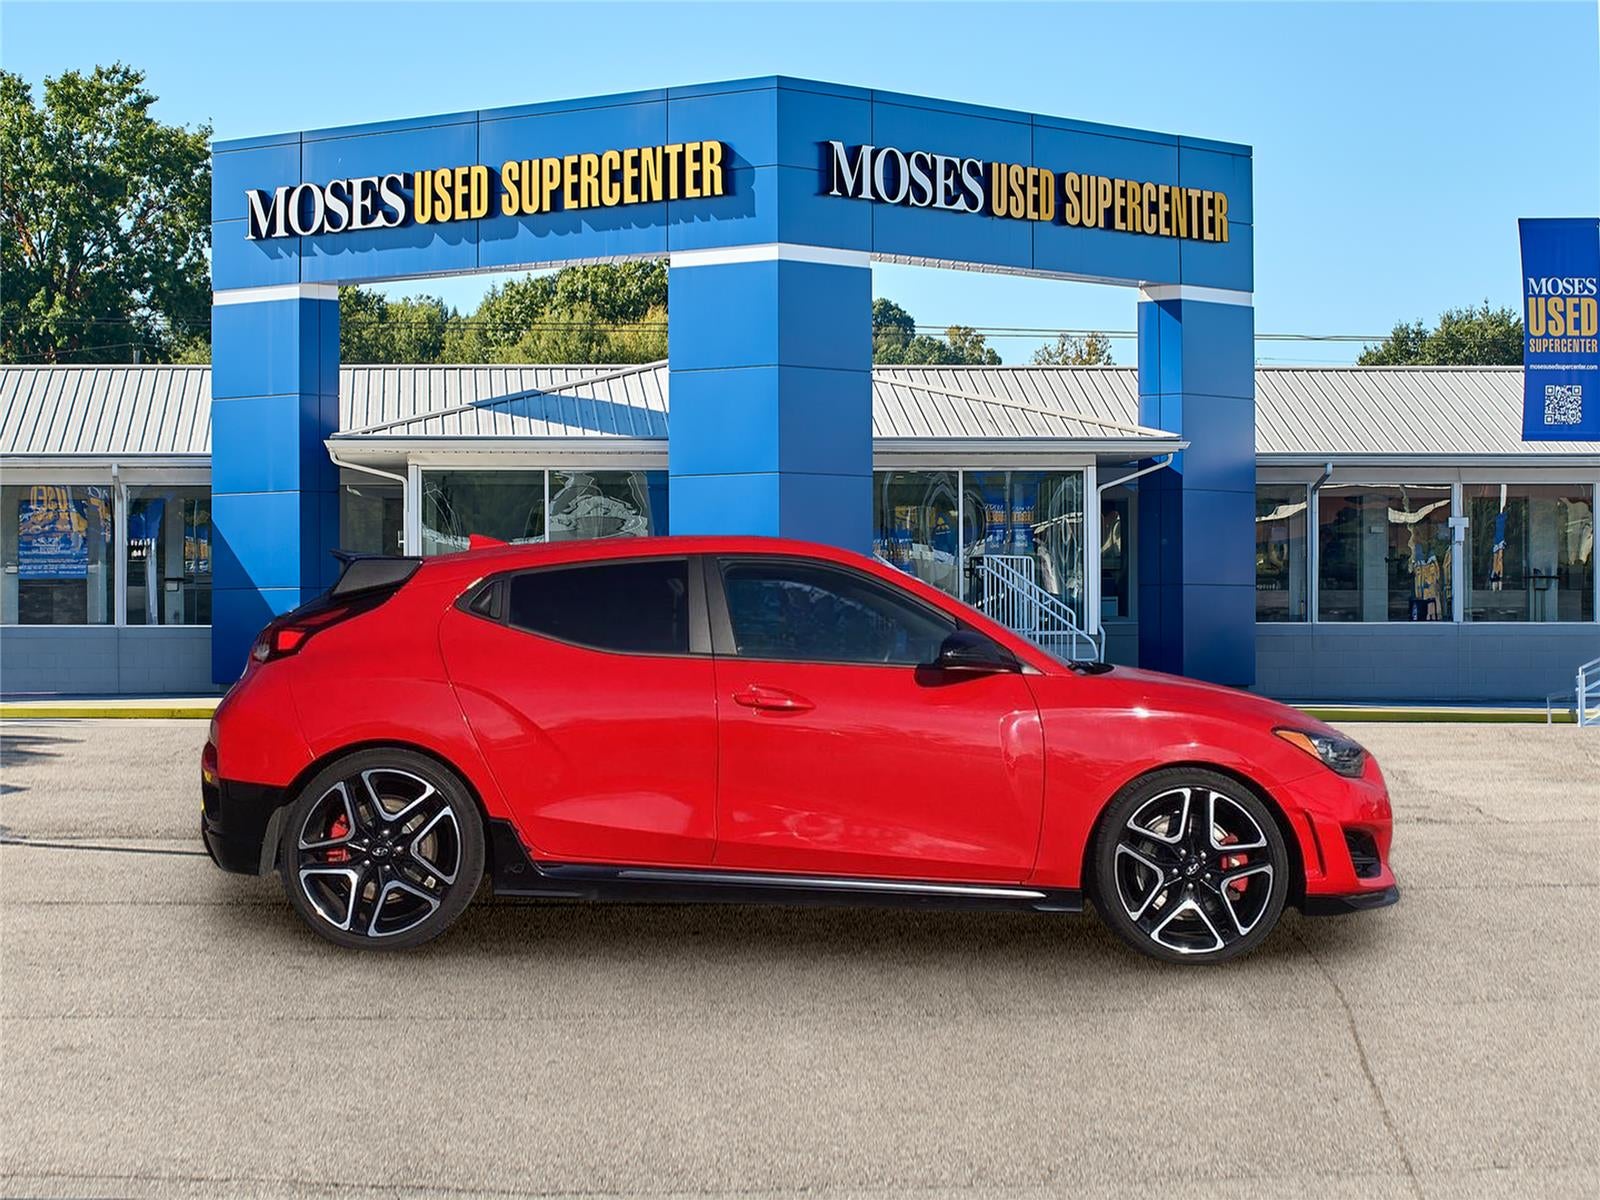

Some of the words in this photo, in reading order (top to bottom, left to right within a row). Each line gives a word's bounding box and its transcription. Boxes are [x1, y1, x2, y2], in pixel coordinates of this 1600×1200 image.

[245, 173, 407, 240] MOSES
[413, 166, 488, 224] USED
[500, 140, 723, 216] SUPERCENTER
[829, 140, 984, 214] MOSES
[991, 161, 1055, 221] USED
[1065, 171, 1230, 243] SUPERCENTER
[1527, 277, 1597, 295] MOSES
[1528, 297, 1598, 336] USED
[1529, 338, 1598, 353] SUPERCENTER
